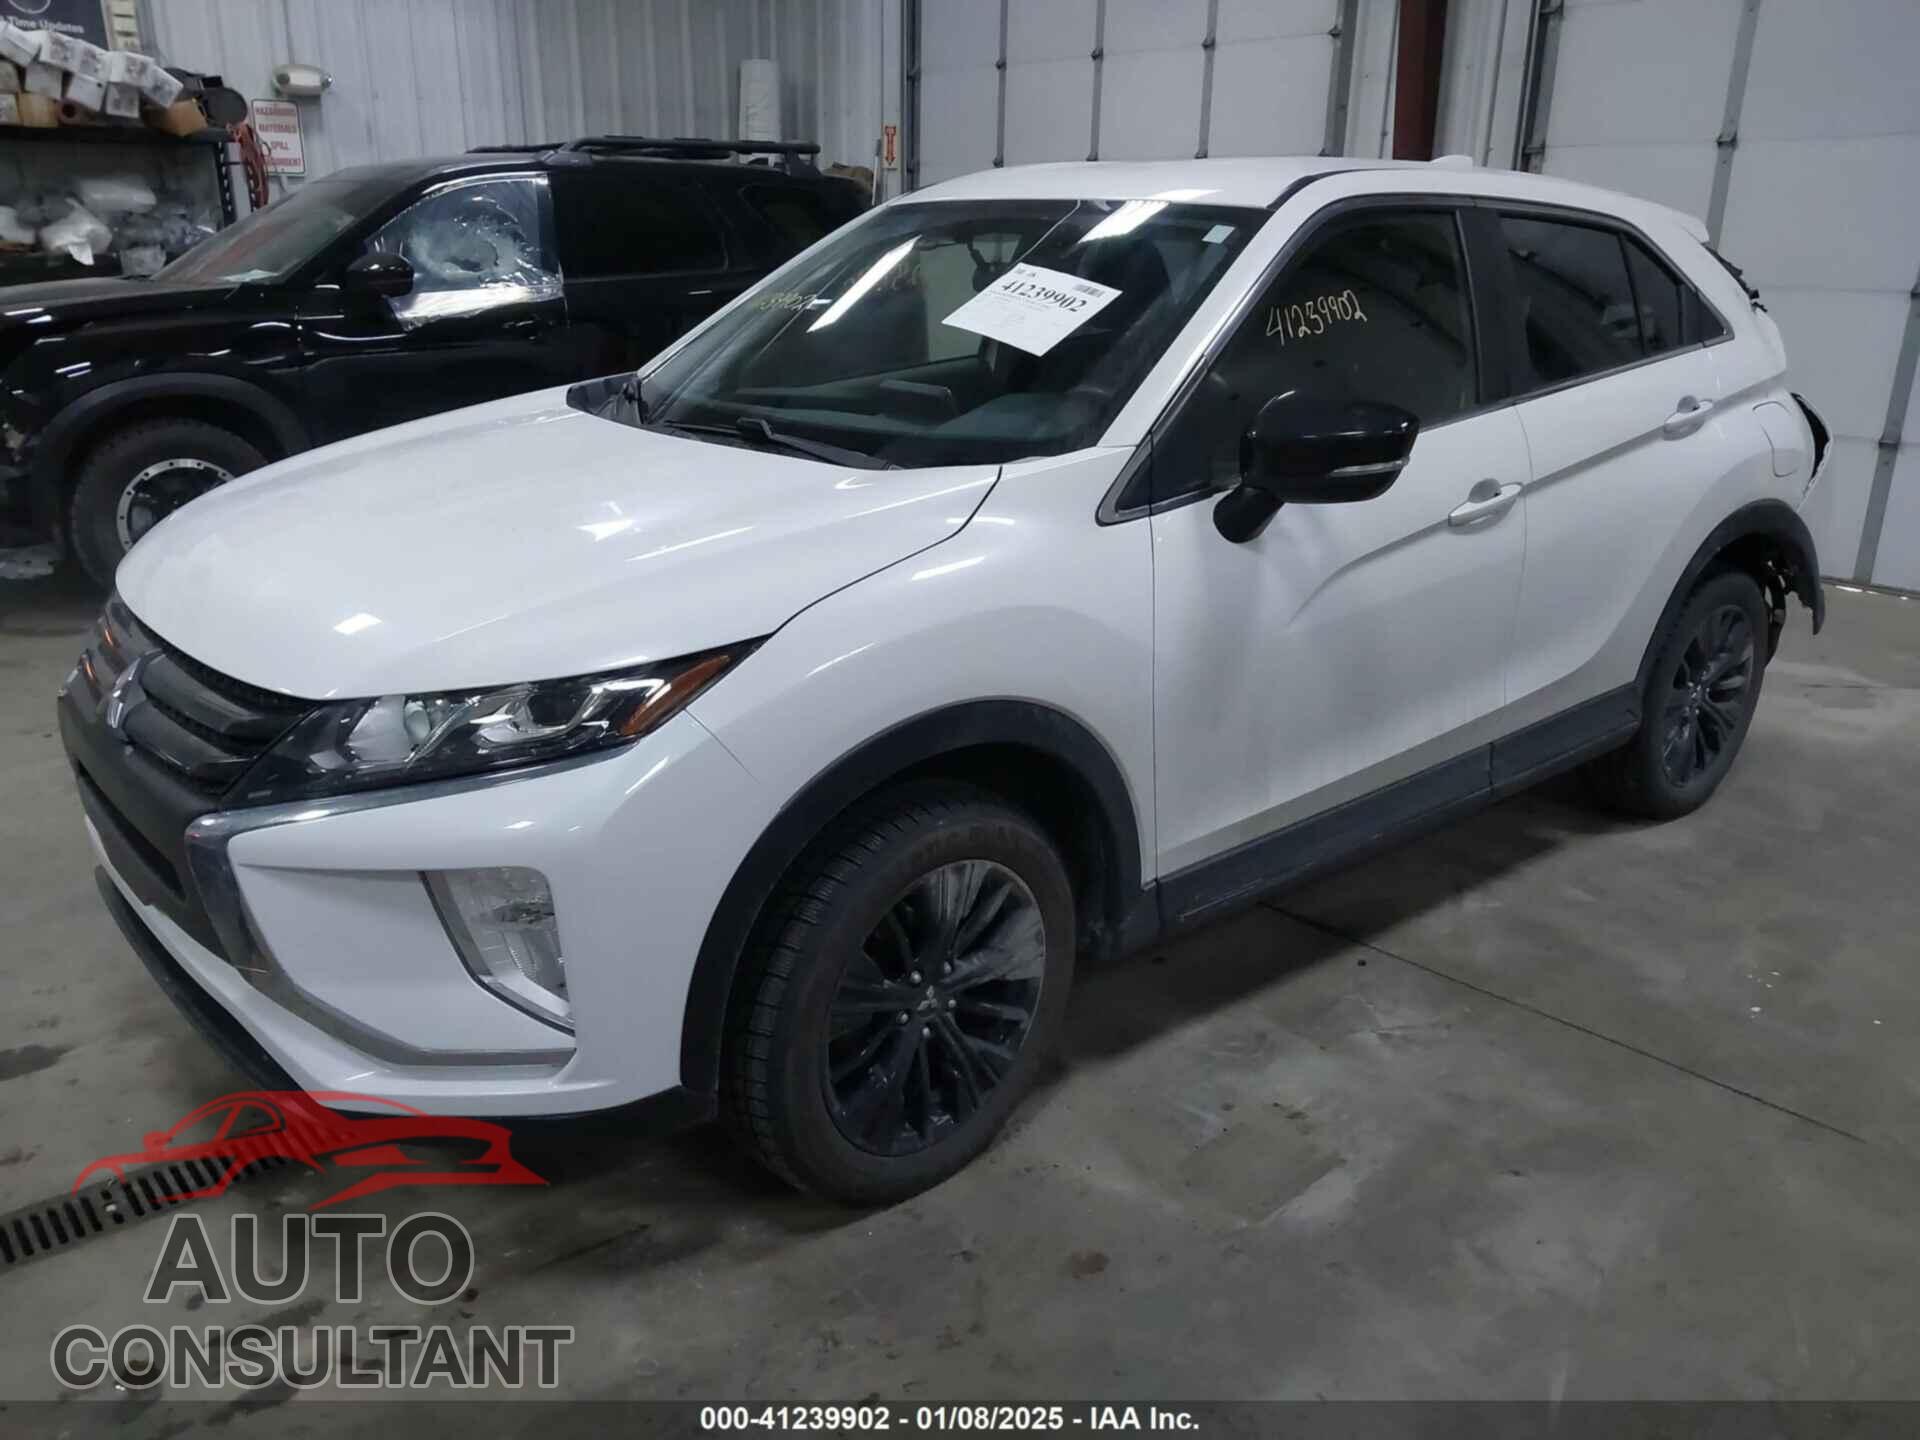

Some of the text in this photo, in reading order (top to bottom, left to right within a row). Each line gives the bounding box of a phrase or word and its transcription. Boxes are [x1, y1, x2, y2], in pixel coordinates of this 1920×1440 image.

[258, 123, 298, 134] MATERIALS
[270, 140, 289, 150] SPILL
[1002, 280, 1087, 313] 41239902
[1266, 289, 1368, 346] 41239902
